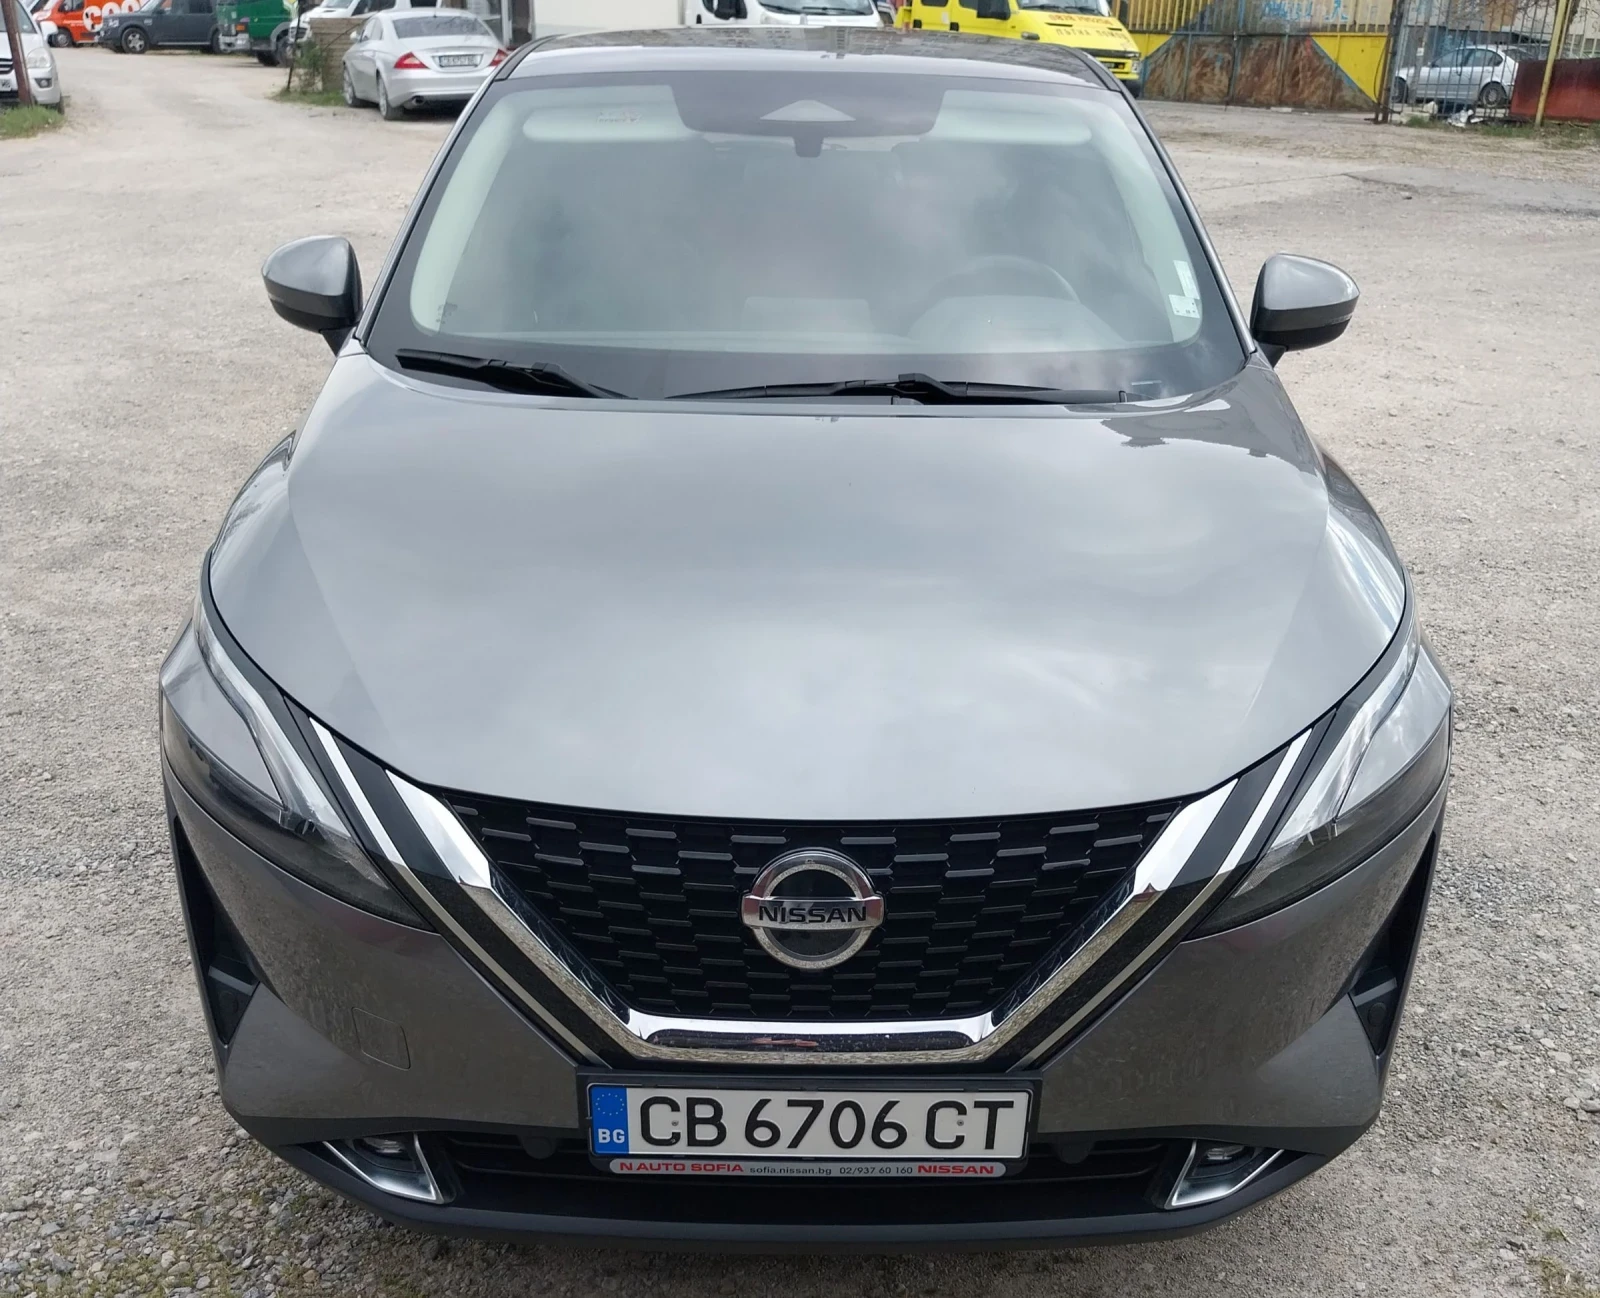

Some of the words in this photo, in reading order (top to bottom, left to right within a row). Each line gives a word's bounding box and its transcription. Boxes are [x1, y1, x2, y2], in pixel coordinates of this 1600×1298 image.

[759, 905, 867, 924] NISSAN
[640, 1096, 727, 1147] CB
[745, 1098, 908, 1150] 6706
[925, 1100, 1014, 1150] CT
[598, 1129, 625, 1144] BG
[620, 1162, 633, 1172] N
[636, 1163, 686, 1172] AUTO
[691, 1163, 744, 1173] SOFIA
[750, 1165, 832, 1176] sofia.nissan.bg
[839, 1165, 876, 1175] 02/937
[879, 1166, 892, 1175] 60
[895, 1166, 913, 1175] 160
[917, 1165, 994, 1175] NISSAN
